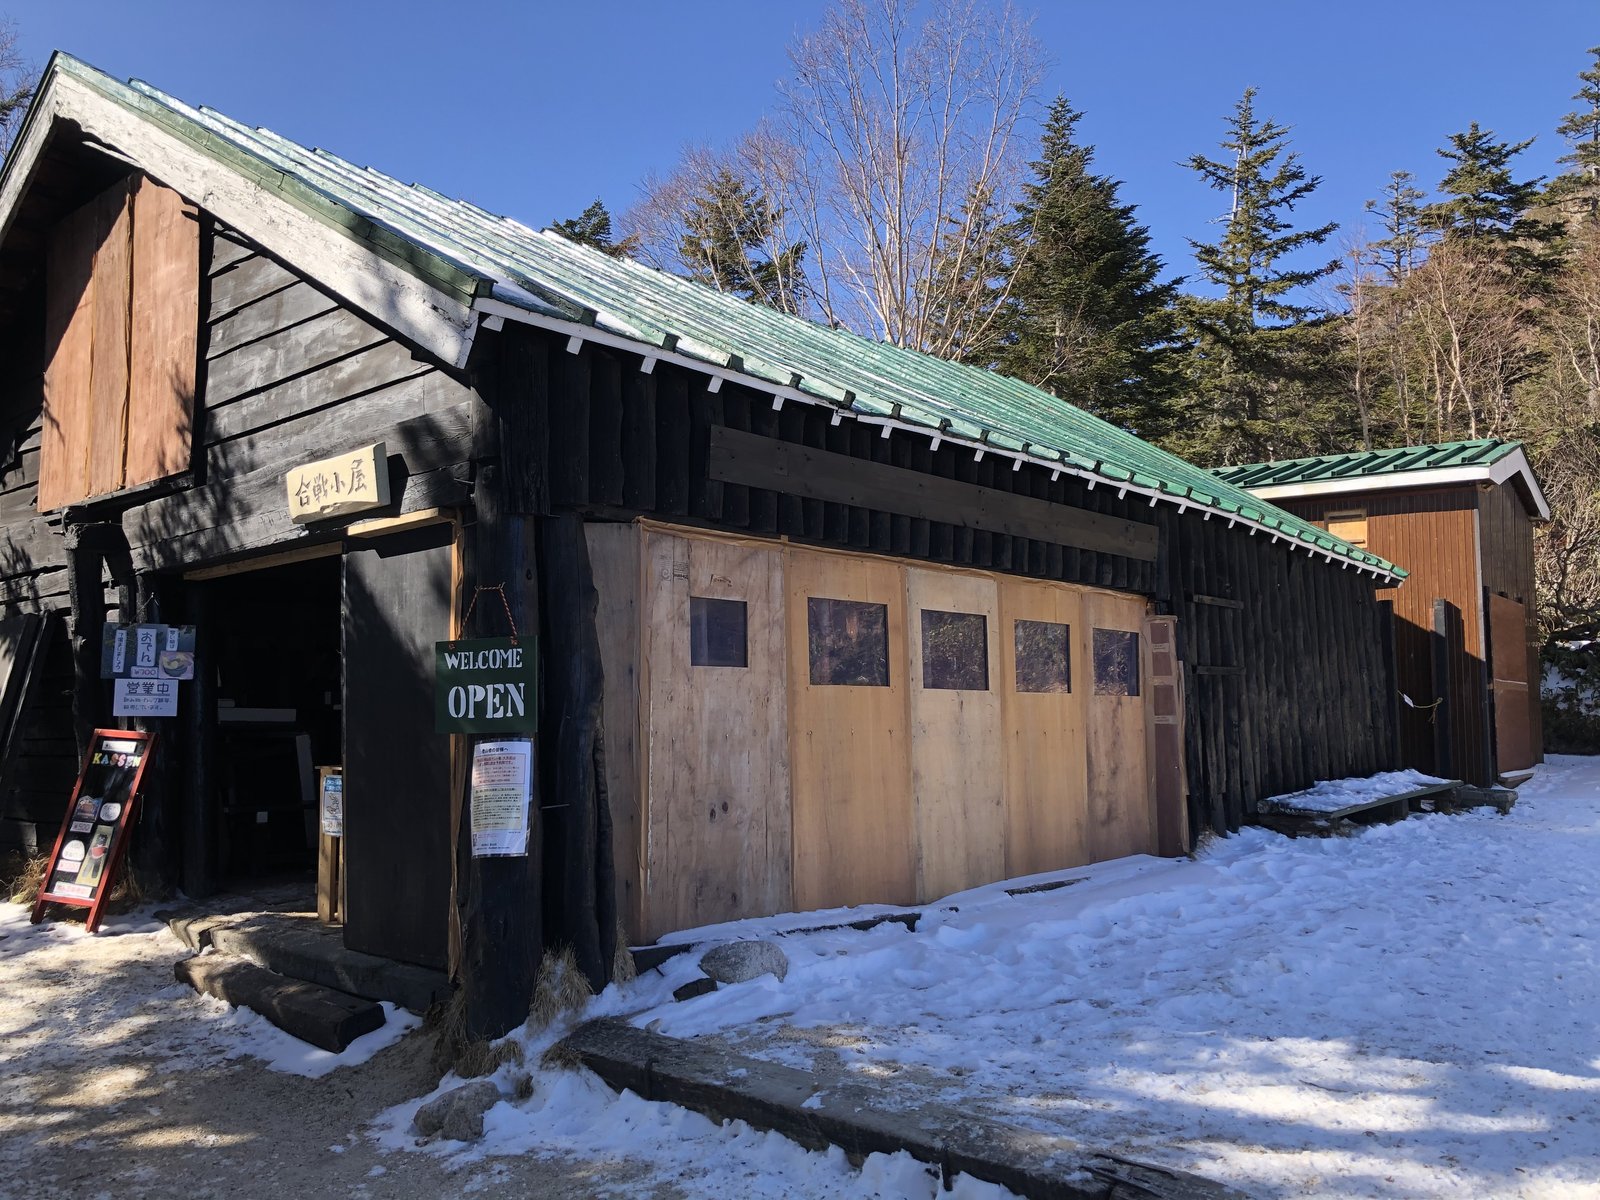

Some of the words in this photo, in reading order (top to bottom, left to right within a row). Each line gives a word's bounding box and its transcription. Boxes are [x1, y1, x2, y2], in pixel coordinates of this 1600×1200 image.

[295, 458, 368, 508] 合戦小屋
[140, 631, 153, 663] おでん
[444, 648, 523, 670] WELCOME
[126, 681, 170, 694] 営業中
[448, 683, 525, 719] OPEN
[92, 752, 143, 768] KASSEN
